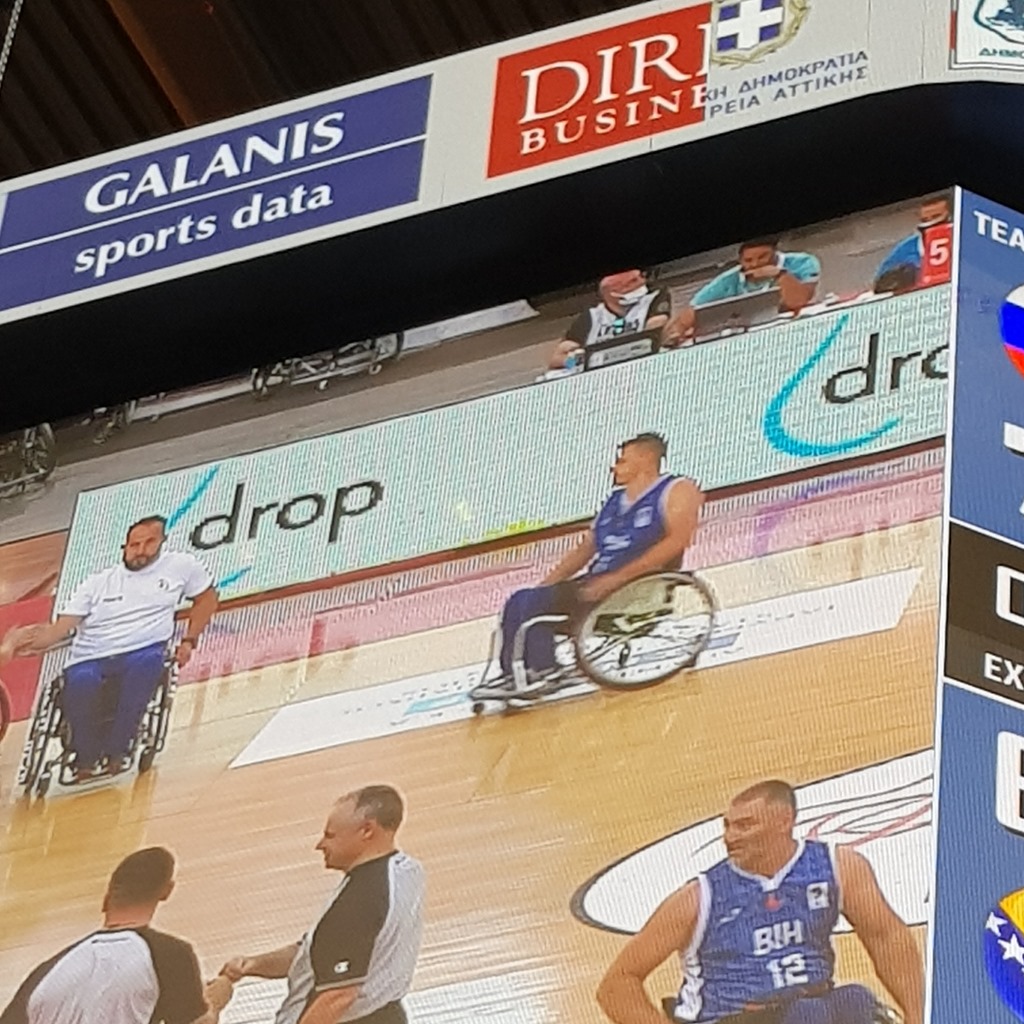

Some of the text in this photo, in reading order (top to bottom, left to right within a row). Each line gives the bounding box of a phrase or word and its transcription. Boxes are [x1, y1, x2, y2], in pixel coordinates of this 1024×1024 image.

[738, 49, 869, 95] ΔΗΜΟΚΡΑΤΙΑ
[773, 65, 869, 102] ΑΤΤΙΚΗΣ
[84, 111, 345, 214] GALANIS
[73, 183, 335, 279] sports data
[928, 237, 950, 267] 5
[190, 480, 386, 551] drop
[752, 918, 804, 957] BIH
[765, 952, 809, 989] 12
